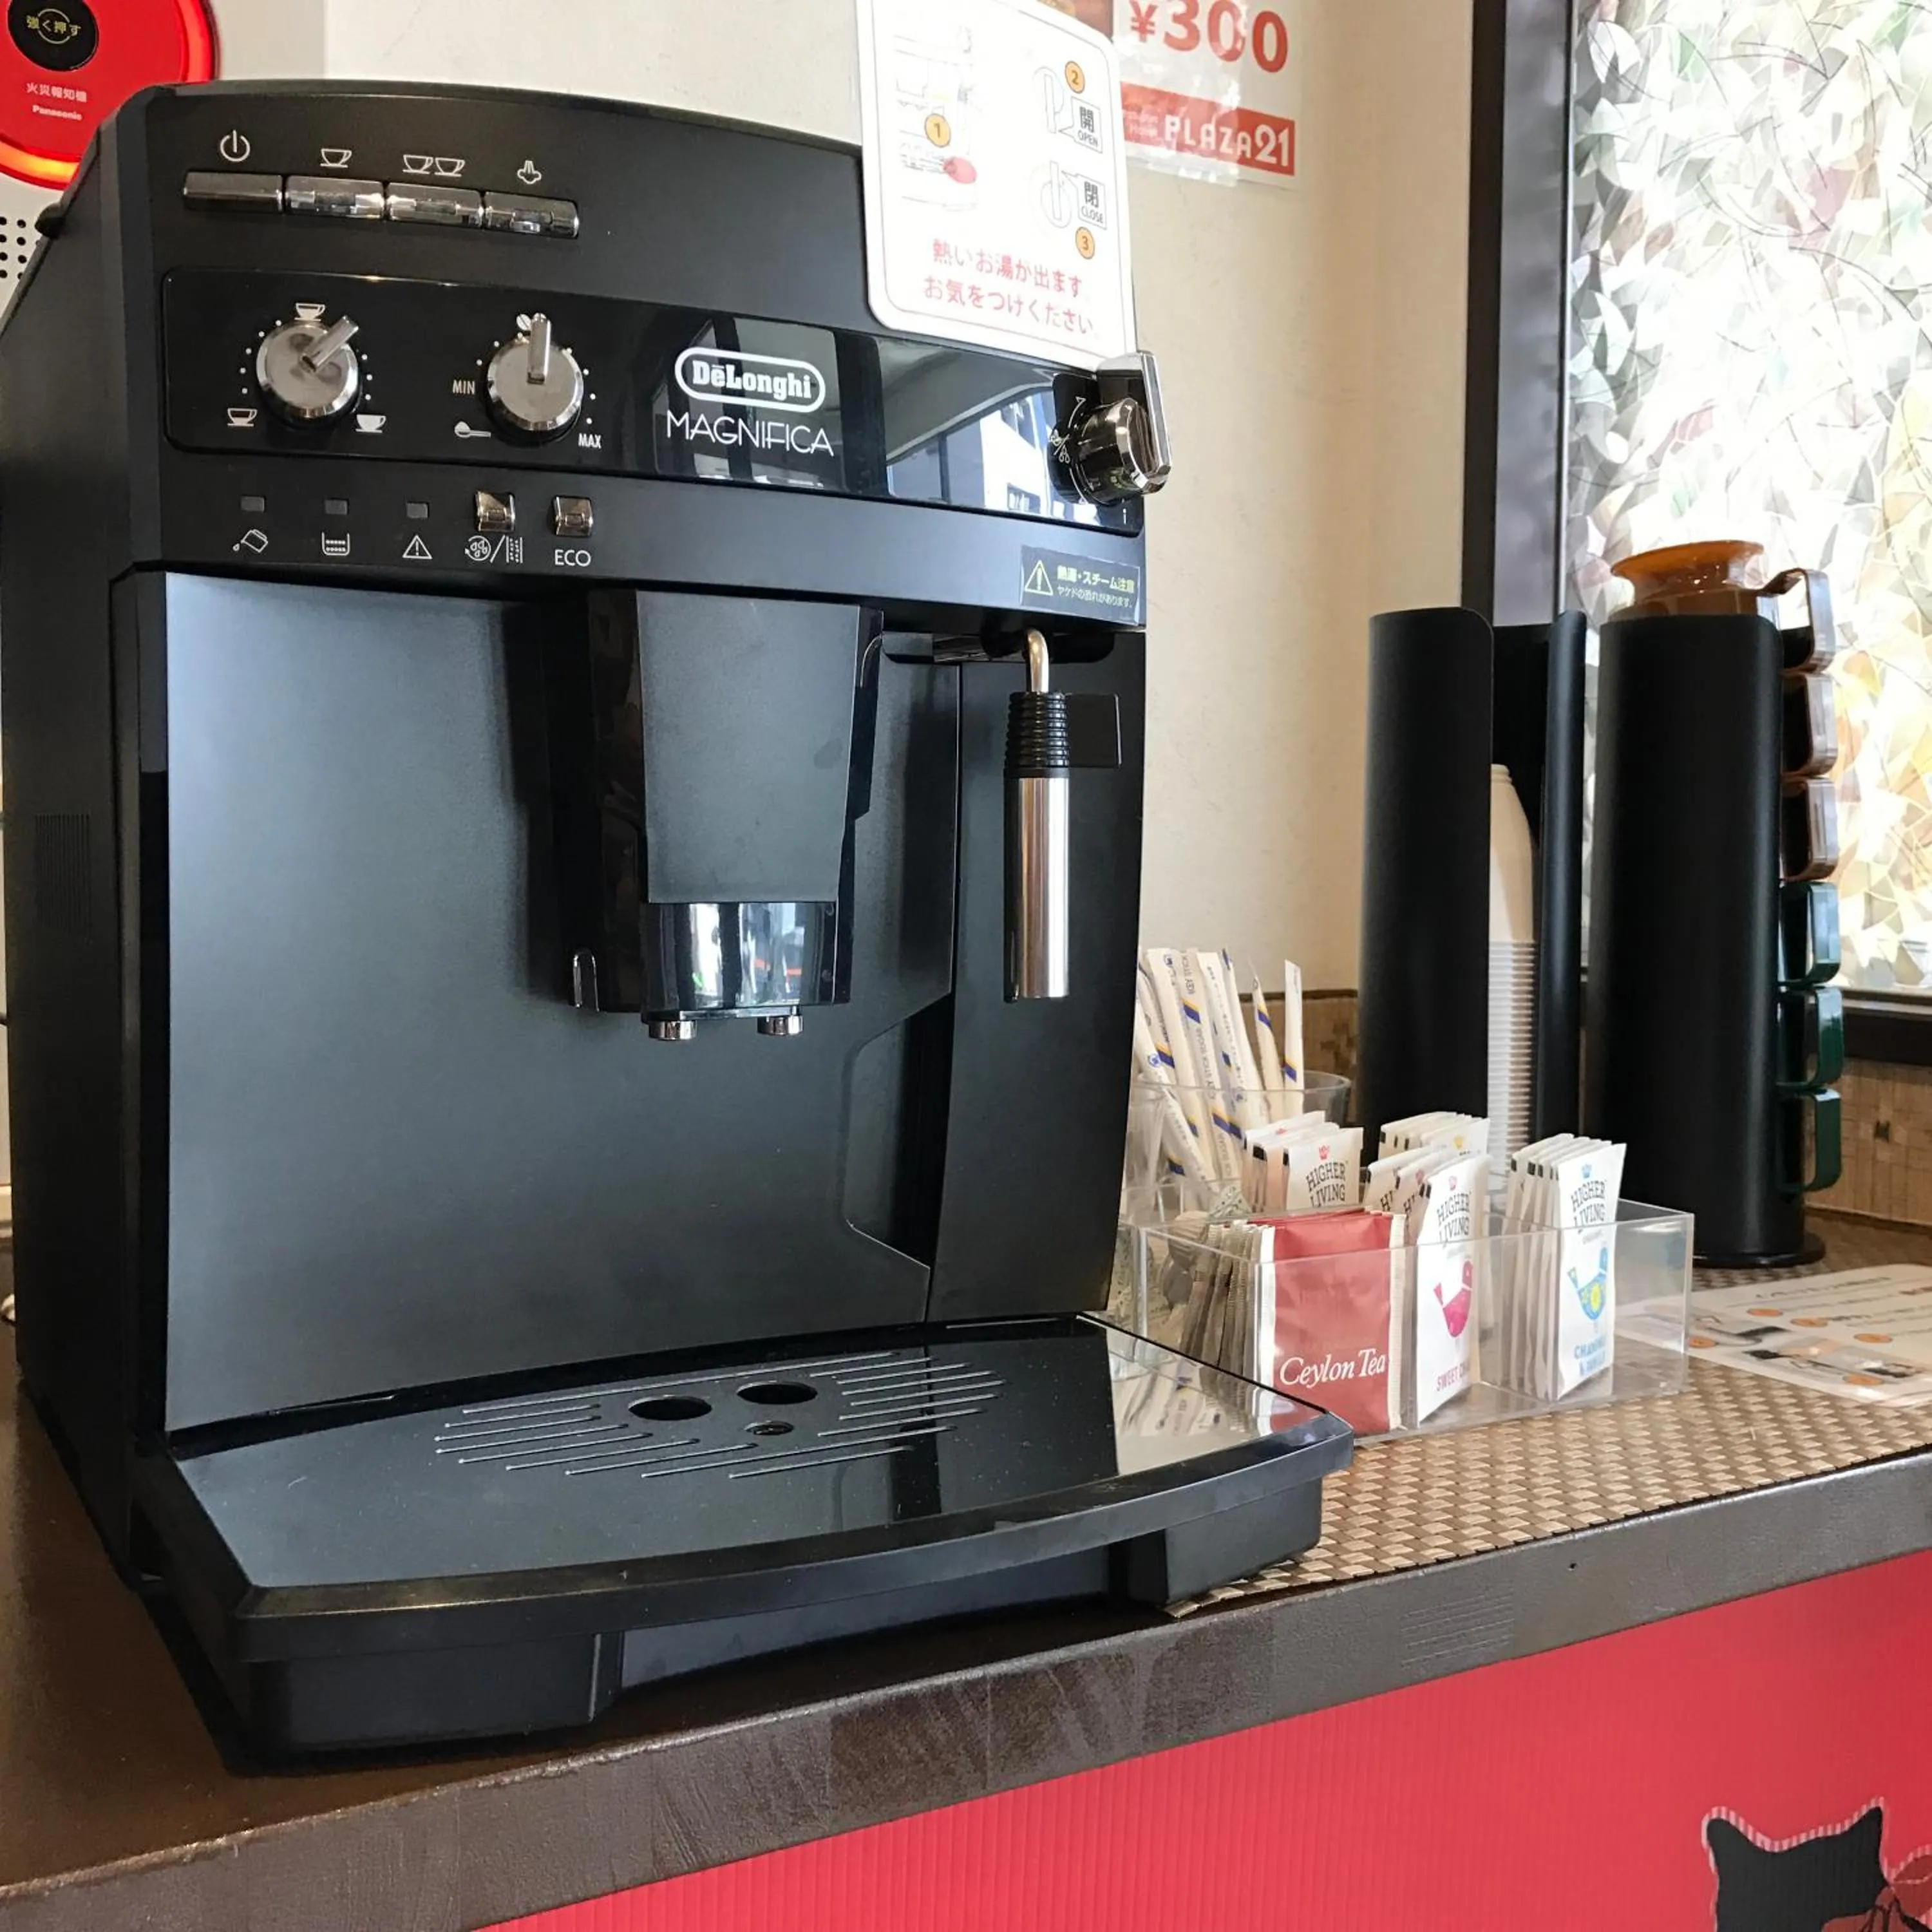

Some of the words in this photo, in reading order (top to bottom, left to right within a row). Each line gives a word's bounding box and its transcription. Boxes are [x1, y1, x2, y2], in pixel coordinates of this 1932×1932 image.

[32, 104, 82, 120] Panasonic
[1079, 106, 1095, 133] 開
[1077, 129, 1098, 147] OPEN
[1084, 181, 1099, 208] 閉
[1081, 205, 1104, 224] CLOSE
[452, 379, 475, 395] MIN
[578, 433, 602, 449] MAX
[667, 409, 835, 457] MAGNIFICA
[554, 549, 591, 567] ECO
[1305, 1161, 1346, 1193] HIGHER
[1310, 1183, 1345, 1208] LIVING
[1571, 1180, 1605, 1213] HIGHER
[1574, 1202, 1605, 1234] LIVING
[1439, 1217, 1470, 1248] LIVING
[1279, 1354, 1354, 1388] Ceylon
[1358, 1348, 1386, 1378] Tea
